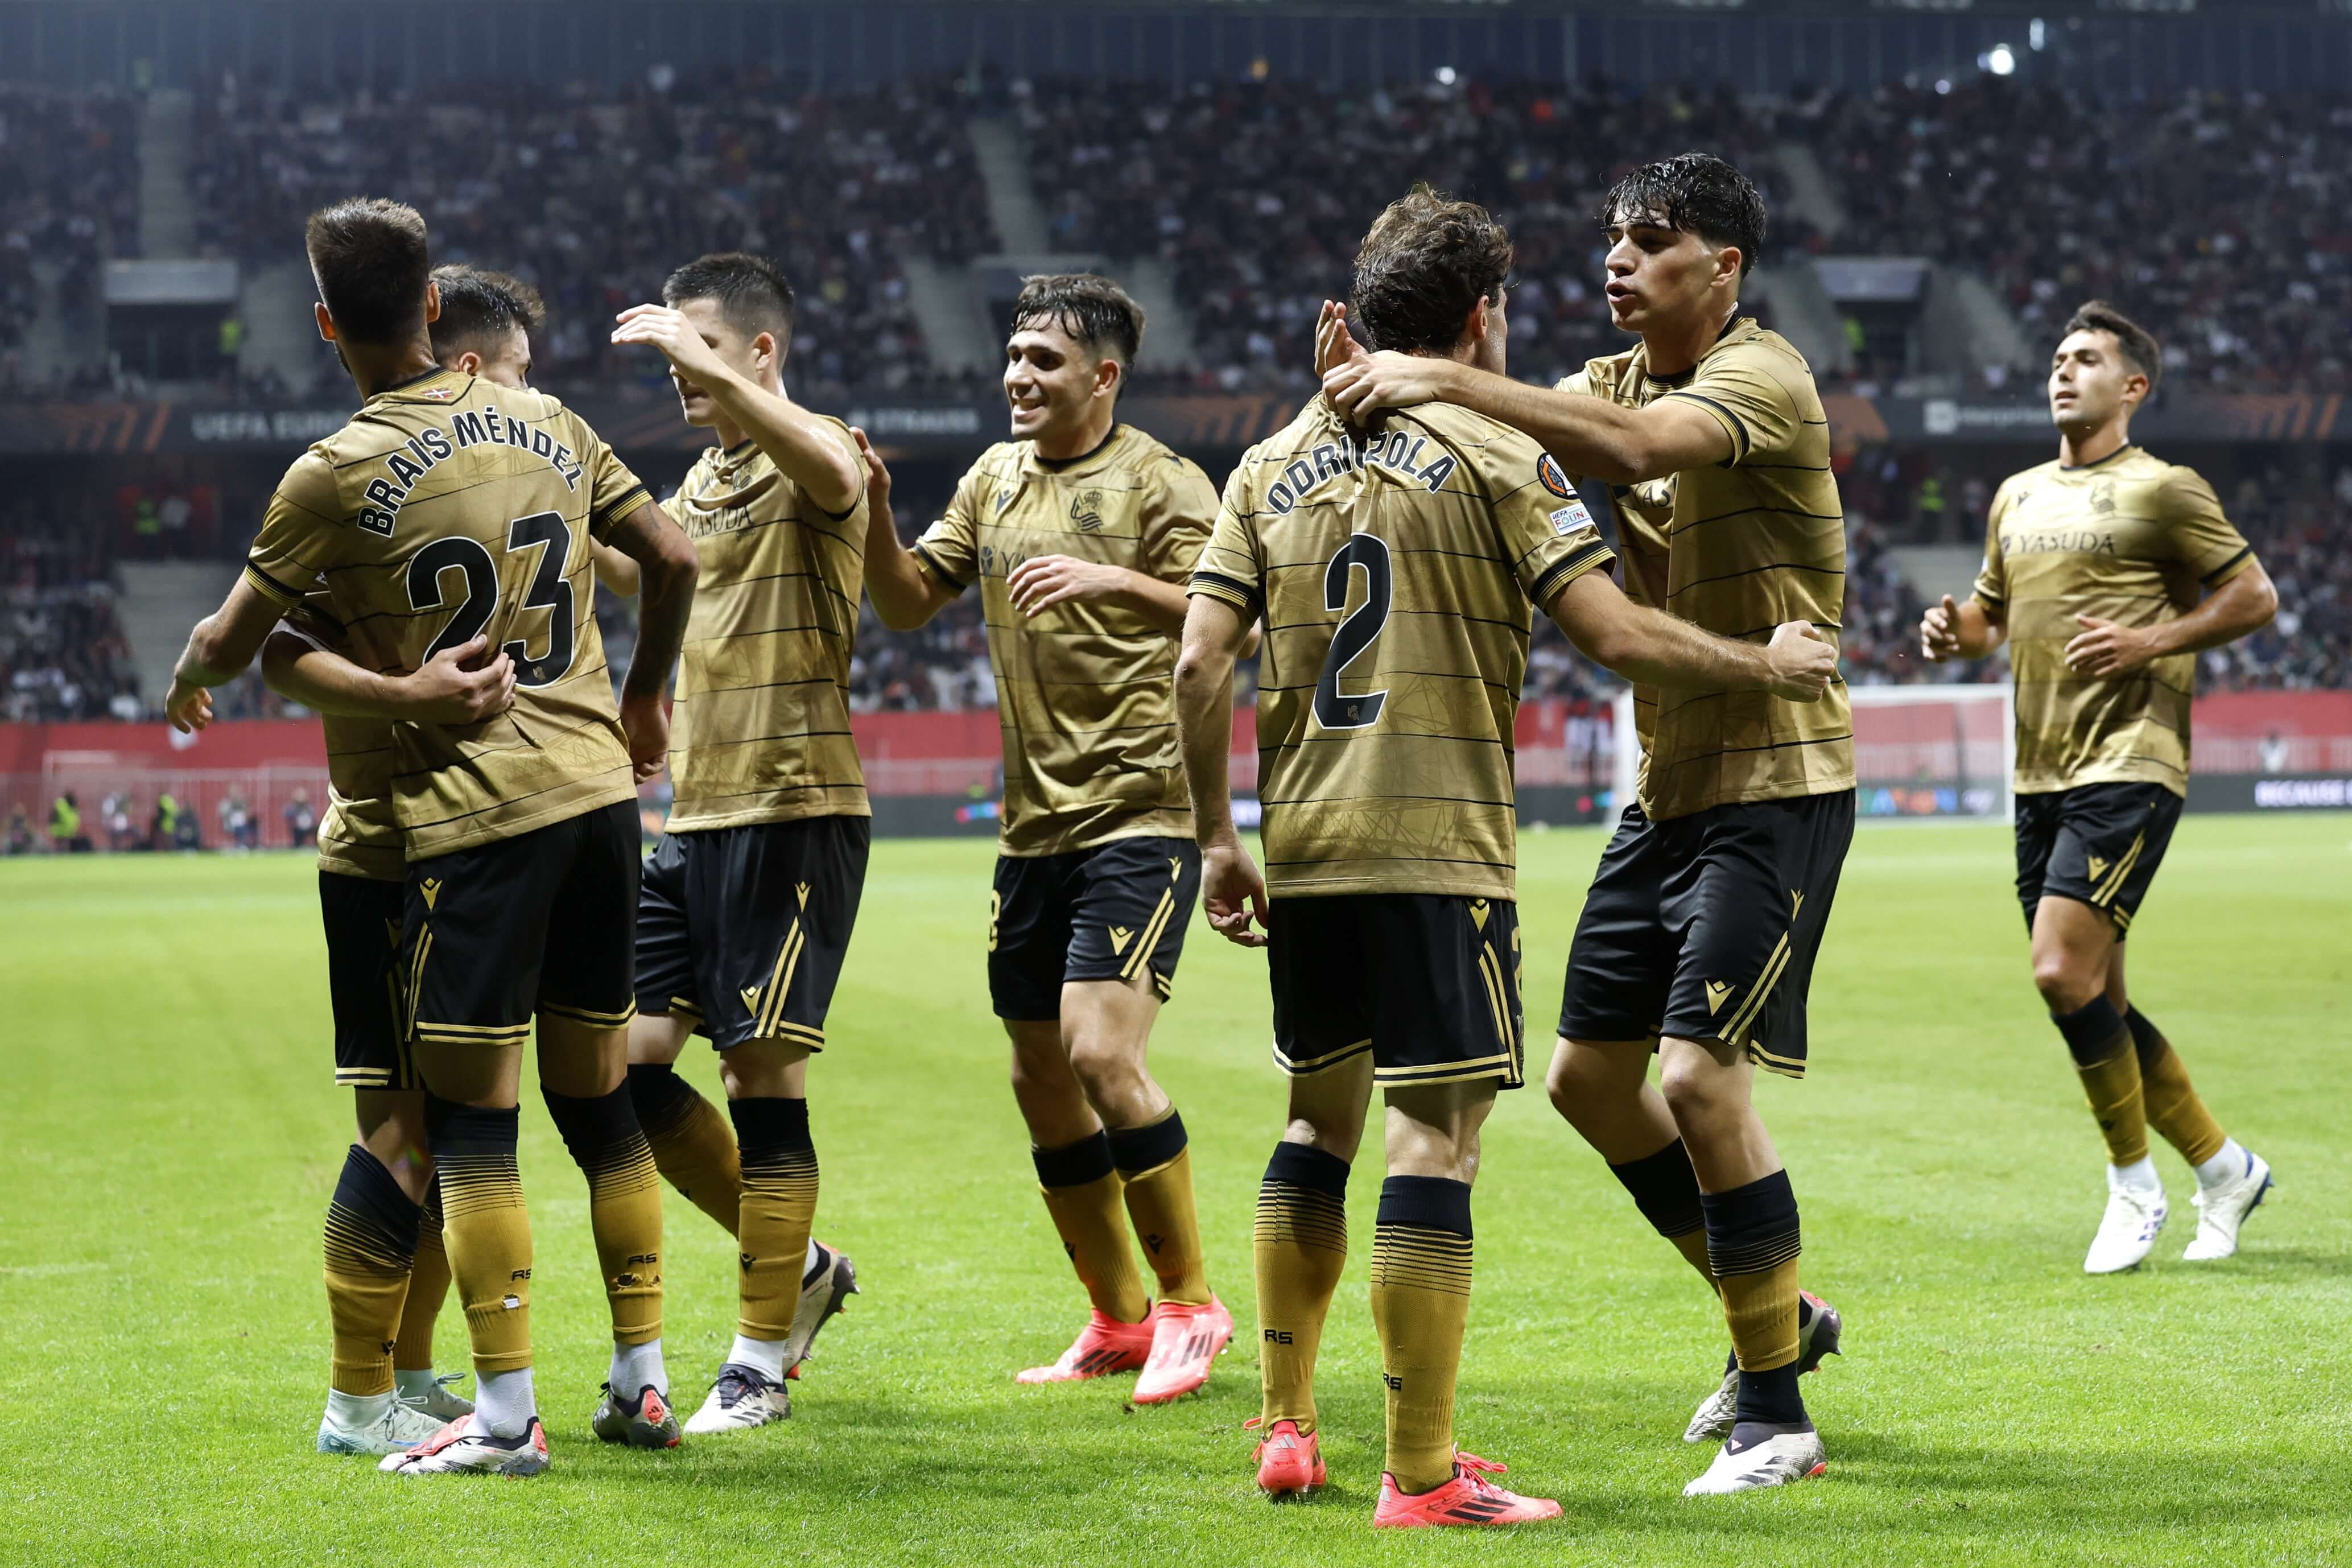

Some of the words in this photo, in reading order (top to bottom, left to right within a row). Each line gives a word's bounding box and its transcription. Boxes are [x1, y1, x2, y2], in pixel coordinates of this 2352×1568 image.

[357, 427, 453, 538] BRAIS
[451, 405, 583, 493] MÉNDEZ
[1552, 510, 1568, 520] UEFA
[1555, 511, 1586, 528] FOUN
[2020, 532, 2115, 554] YASUDA
[406, 510, 575, 690] 23
[1313, 532, 1392, 729] 2
